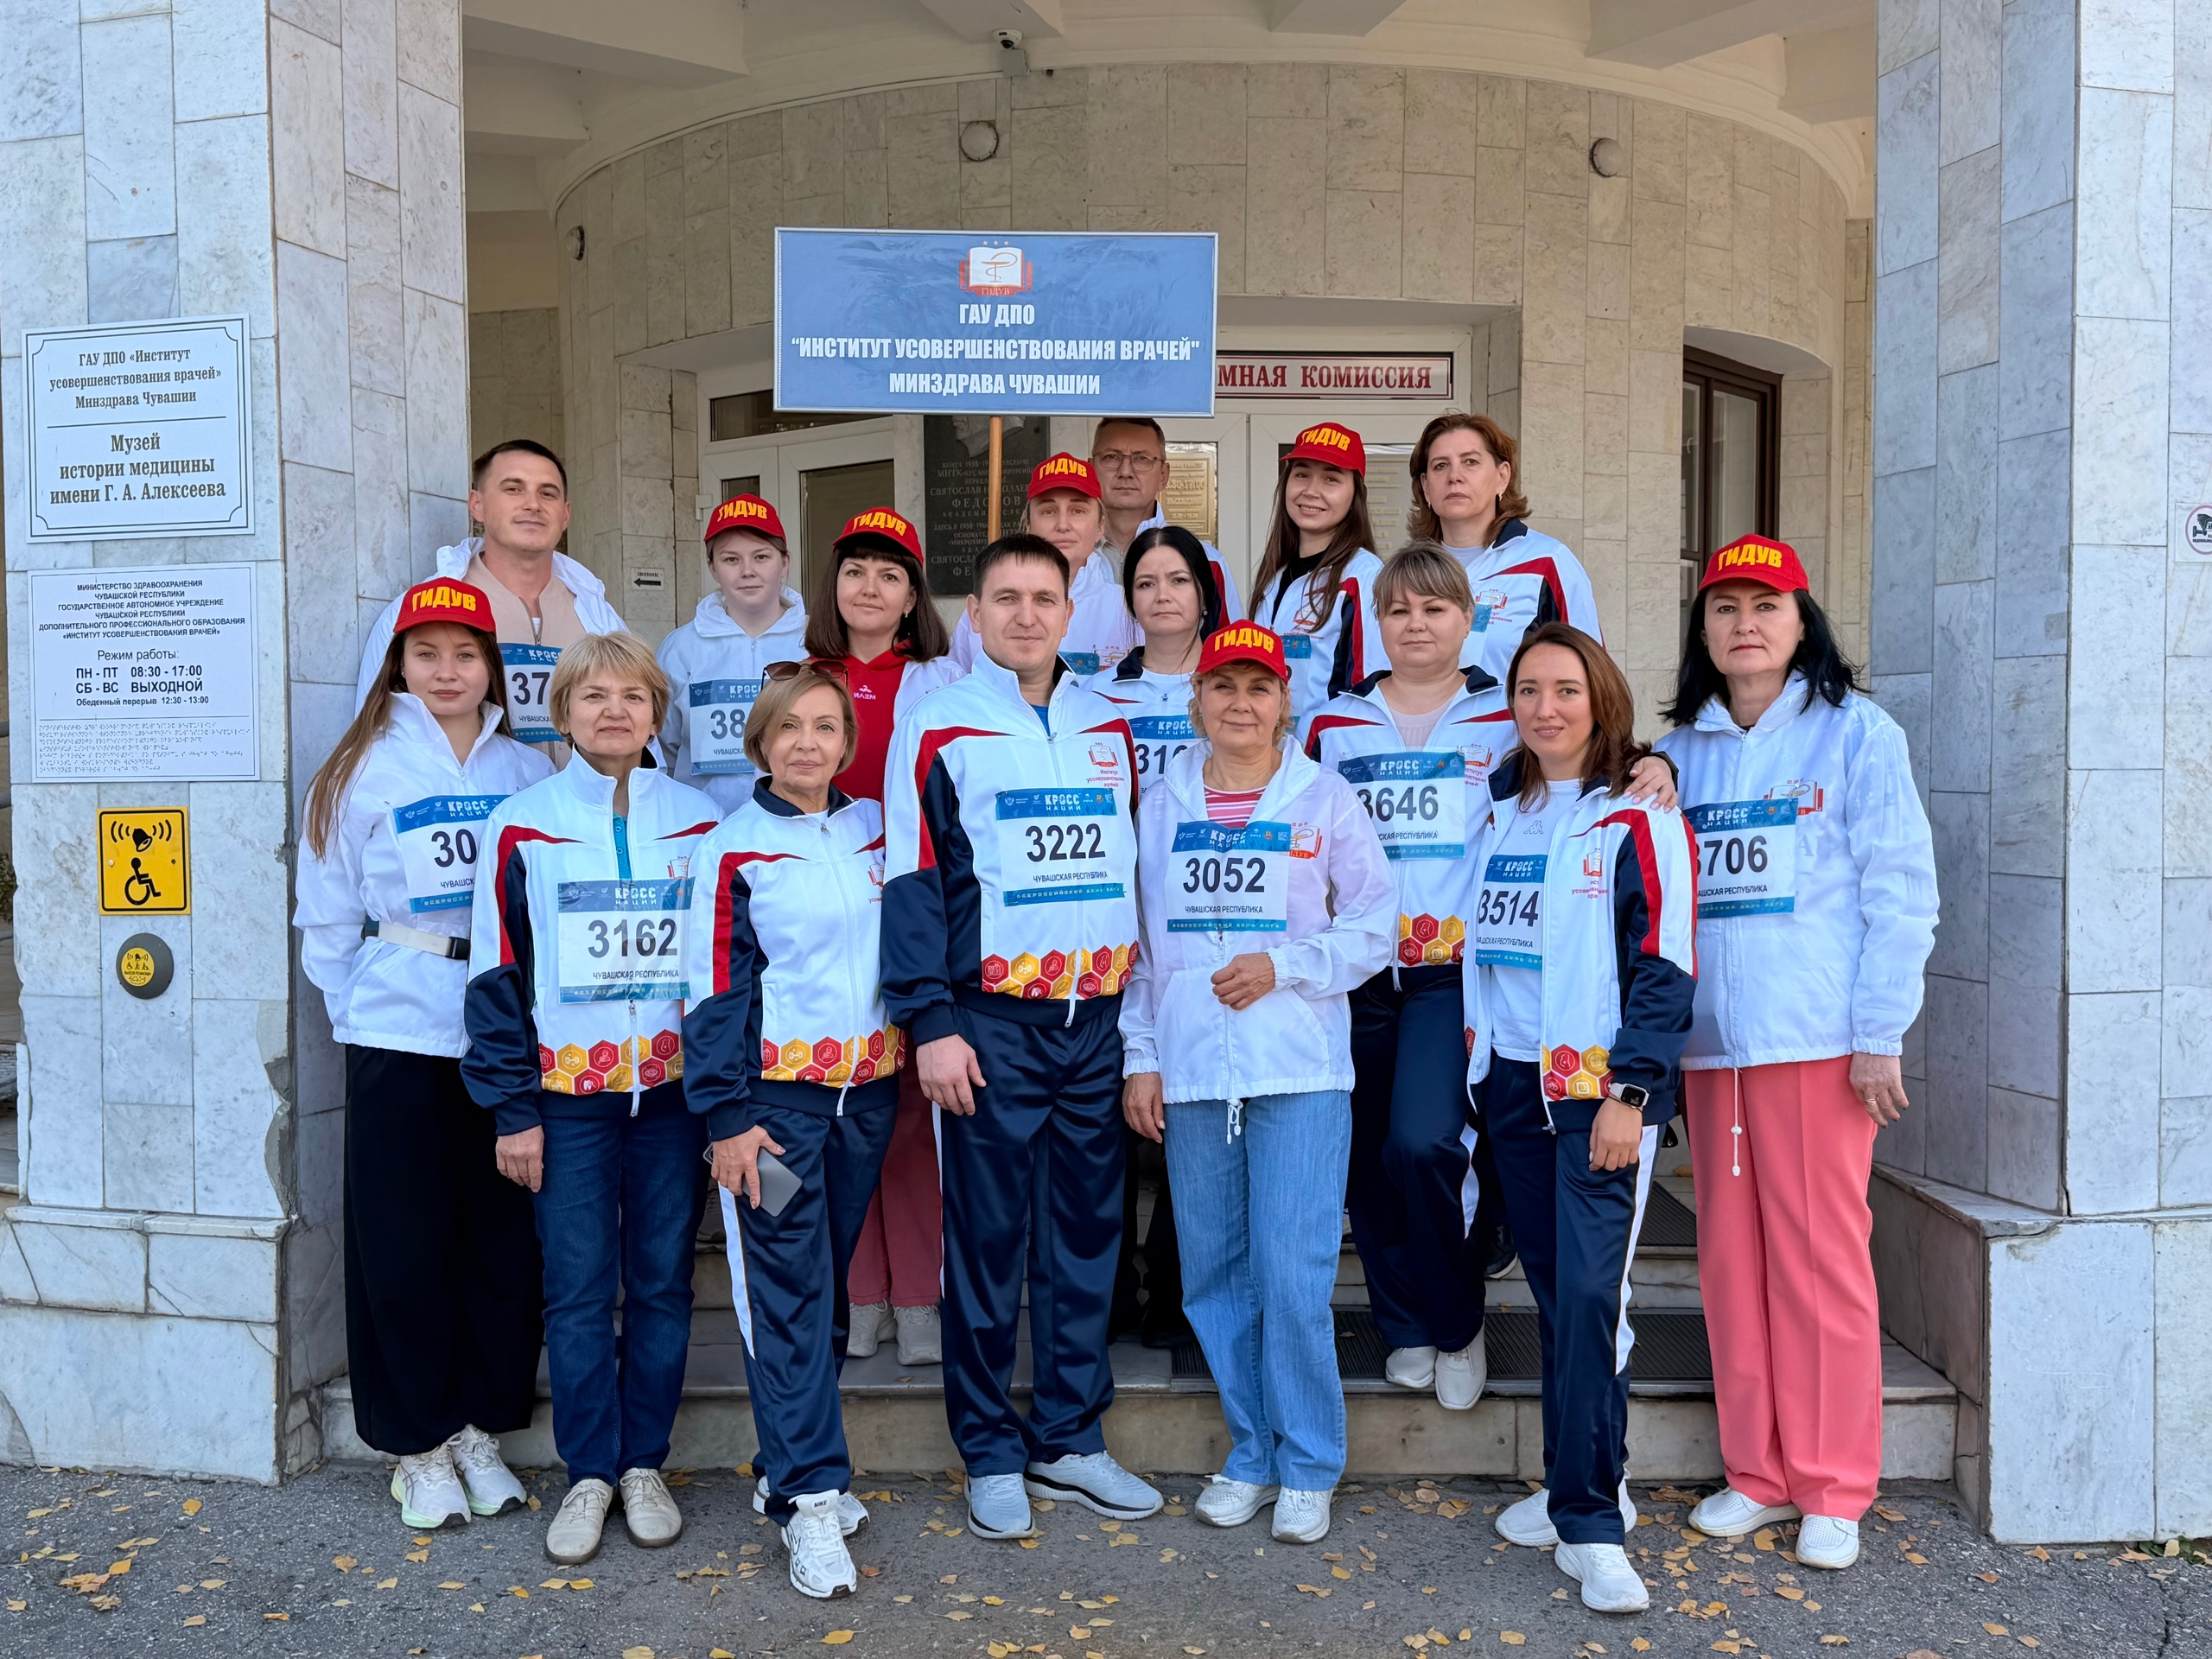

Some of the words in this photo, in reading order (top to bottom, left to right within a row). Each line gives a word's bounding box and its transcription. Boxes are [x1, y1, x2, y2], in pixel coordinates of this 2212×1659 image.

[959, 304, 991, 324] ГАУ
[995, 304, 1035, 327] ДПО
[79, 353, 99, 366] ГАУ
[103, 351, 126, 367] ДПО
[130, 349, 191, 363] «Институт
[895, 338, 1116, 361] УСОВЕРШЕНСТВОВАНИЯ
[49, 371, 171, 391] усовершенствования
[174, 366, 221, 381] врачей»
[889, 373, 1006, 397] МИНЗДРАВА
[1009, 374, 1101, 396] ЧУВАШИИ
[1217, 365, 1287, 387] МНАЯ
[1300, 365, 1432, 389] КОМИССИЯ
[75, 395, 139, 409] Минздрава
[143, 391, 196, 405] Чувашии
[111, 432, 161, 454] Музей
[1300, 427, 1351, 451] ГИДУВ
[60, 461, 124, 480] истории
[129, 458, 215, 477] медицины
[1039, 457, 1088, 480] ГИДУВ
[50, 488, 100, 505] имени
[105, 485, 118, 502] Г.
[122, 483, 137, 501] А.
[141, 482, 226, 499] Алексеева
[931, 486, 982, 496] СВЯТОСЛАВ
[716, 499, 768, 523] ГИДУВ
[951, 496, 1020, 508] ФЕДООВ
[852, 512, 907, 537] ГИДУВ
[1718, 543, 1783, 571] ГИДУВ
[77, 582, 131, 591] МИНИСТЕРСТВО
[133, 580, 203, 589] ЗДРАВООХРАНЕНИЯ
[95, 591, 138, 601] ЧУВАШСКОЙ
[139, 590, 185, 599] РЕСПУБЛИКИ
[412, 586, 477, 613] ГИДУВ
[58, 601, 124, 611] ГОСУДАРСТВЕННОЕ
[126, 600, 175, 609] АВТОНОМНОЕ
[175, 599, 224, 607] УЧРЕЖДЕНИЕ
[95, 610, 138, 620] ЧУВАШСКОЙ
[140, 609, 185, 618] РЕСПУБЛИКИ
[39, 620, 108, 632] ДОПОЛНИТЕЛЬНОГО
[109, 619, 191, 629] ПРОФЕССИОНАЛЬНОГО
[192, 618, 245, 626] ОБРАЗОВАНИЯ
[102, 629, 188, 639] УСОВЕРШЕНСТВОВАНИЯ
[1214, 627, 1274, 654] ГИДУВ
[98, 650, 133, 661] Режим
[136, 648, 180, 663] работы:
[76, 667, 92, 679] ПН
[103, 667, 118, 678] ПТ
[130, 666, 162, 677] 08:30
[172, 664, 202, 677] 17:00
[75, 683, 92, 695] СБ
[103, 682, 119, 693] ВС
[130, 677, 203, 695] ВЫХОДНОЙ
[512, 671, 550, 705] 37
[76, 697, 121, 707] Обеденный
[161, 696, 183, 705] 12:30
[188, 696, 209, 704] 13:00
[711, 709, 746, 740] 38
[1380, 760, 1420, 771] КРОСС
[448, 800, 488, 812] КРОСС
[1045, 794, 1080, 805] КРОСС
[1357, 786, 1439, 822] 3646
[1707, 808, 1749, 822] КРОСС
[1707, 818, 1748, 827] НАЦИИ
[1025, 823, 1106, 862] 3222
[1211, 829, 1246, 842] КРОСС
[1395, 830, 1439, 840] РЕСПУБЛИКА
[431, 829, 477, 868] 30
[1183, 857, 1266, 893] 3052
[1504, 861, 1534, 872] КРОСС
[1033, 874, 1071, 882] ЧУВАШСКАЯ
[1072, 870, 1108, 880] РЕСПУБЛИКА
[614, 887, 657, 899] КРОСС
[1724, 884, 1768, 894] РЕСПУБЛИКА
[1478, 889, 1539, 927] 3514
[588, 918, 677, 958] 3162
[634, 969, 679, 978] РЕСПУБЛИКА
